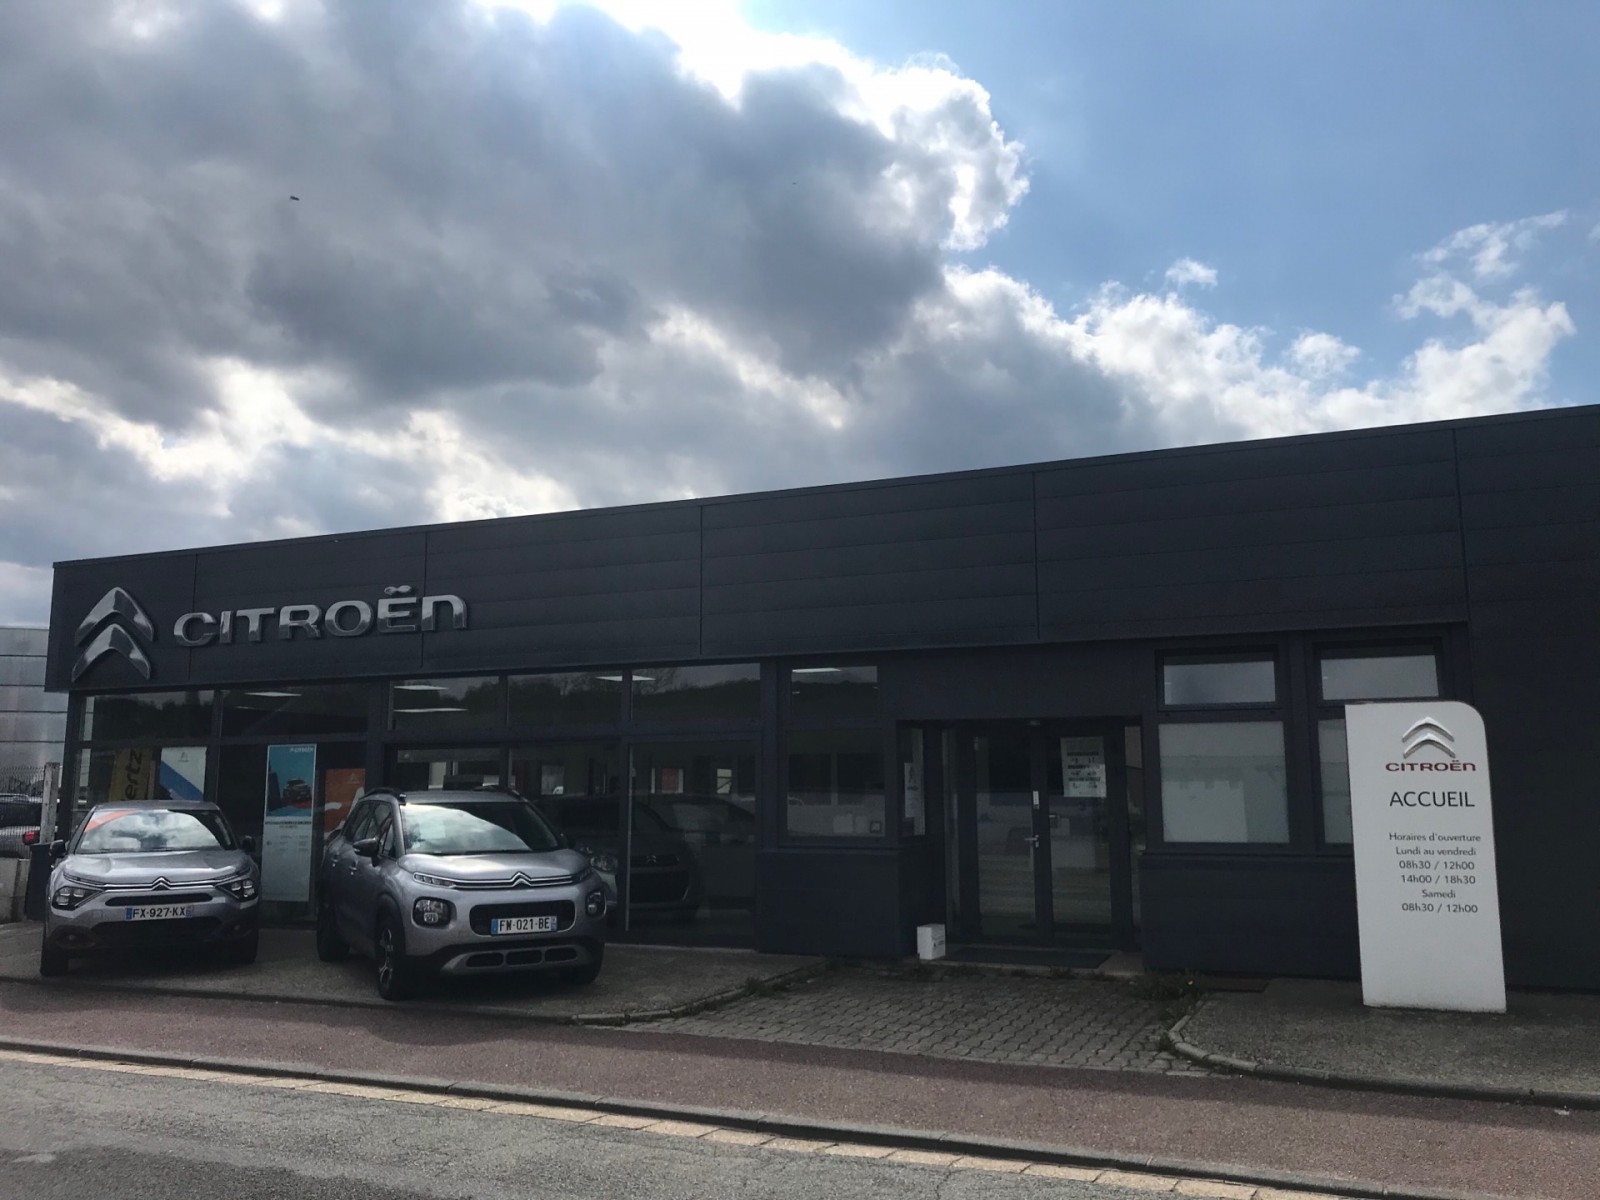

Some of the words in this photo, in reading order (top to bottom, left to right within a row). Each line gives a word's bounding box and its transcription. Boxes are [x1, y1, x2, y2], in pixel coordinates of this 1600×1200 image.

[1389, 791, 1476, 807] ACCUEIL
[1389, 832, 1427, 841] Horaires
[1428, 832, 1482, 842] d'ouverture
[1395, 846, 1421, 855] Lundi
[1437, 846, 1477, 856] vendredi
[1399, 860, 1431, 870] 08h30
[1434, 861, 1440, 870] /
[1443, 860, 1475, 870] 12h00
[1401, 874, 1432, 884] 14h00
[1434, 875, 1440, 884] /
[1444, 875, 1476, 884] 18h30
[1421, 888, 1456, 898] Samedi
[1401, 902, 1434, 912] 08h30
[1437, 903, 1443, 913] /
[1446, 903, 1478, 913] 12h00
